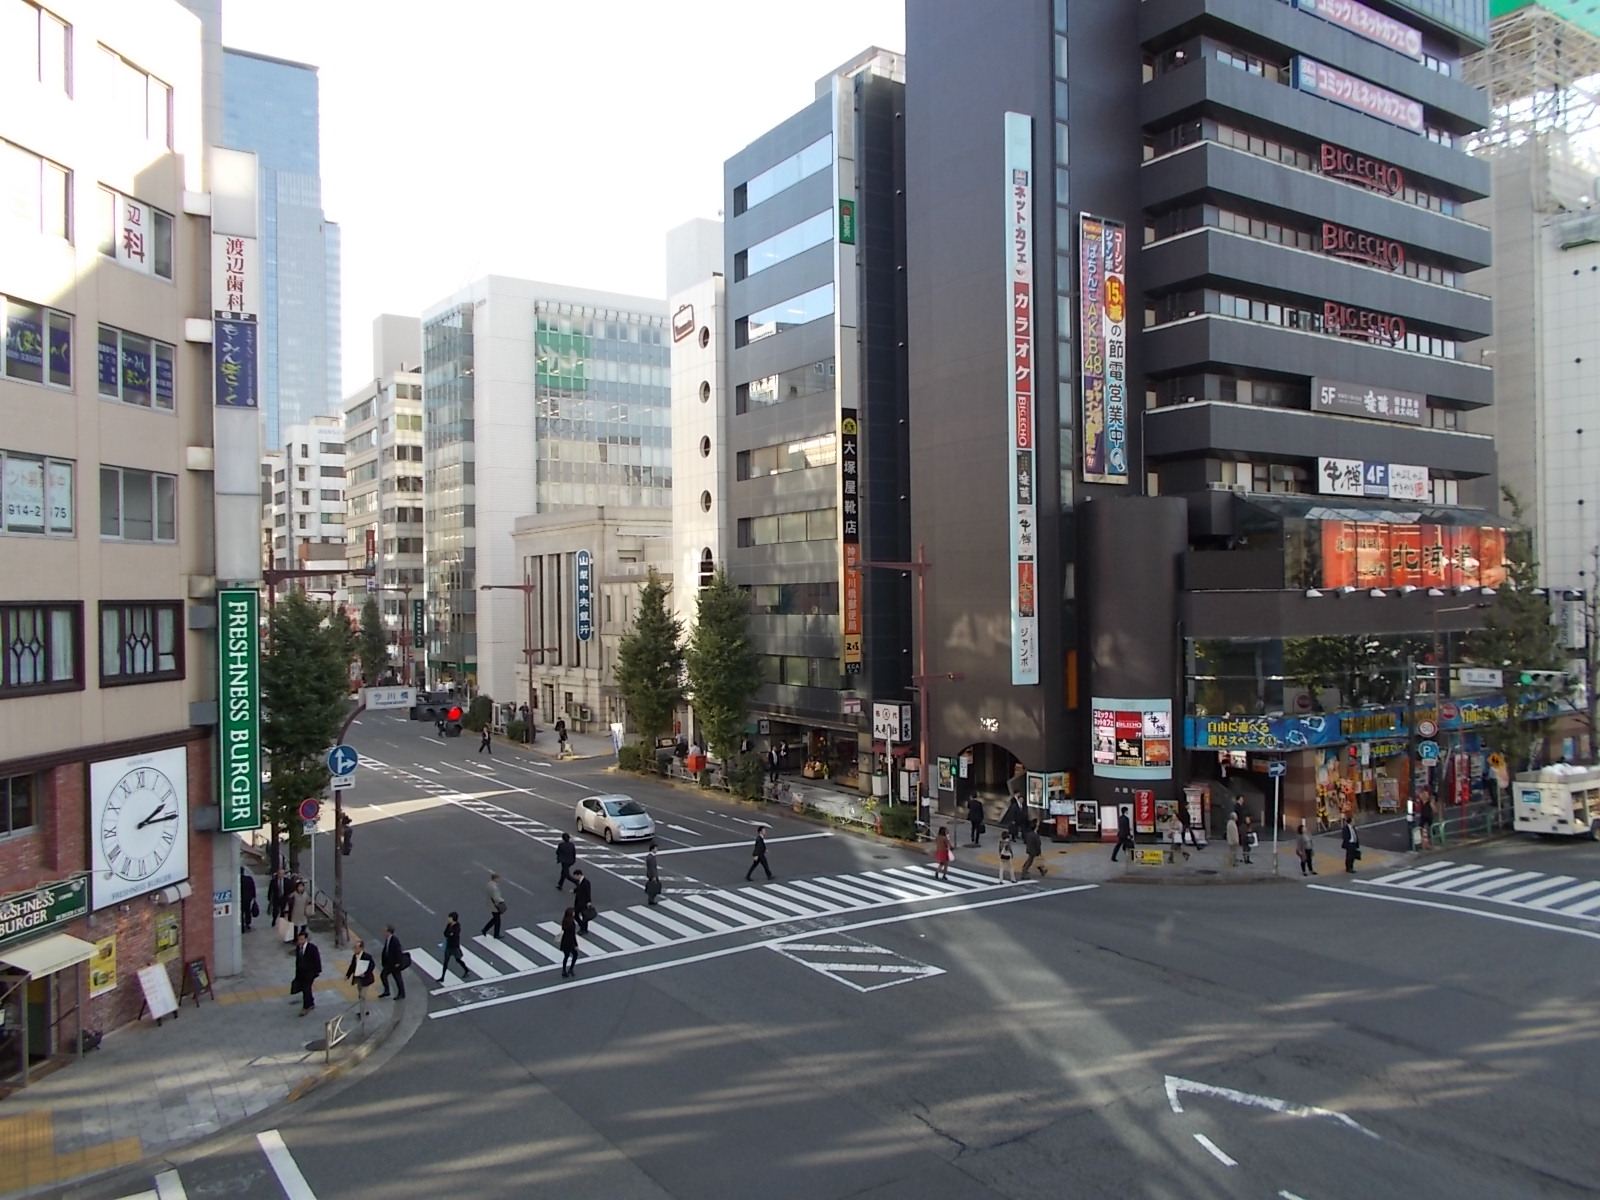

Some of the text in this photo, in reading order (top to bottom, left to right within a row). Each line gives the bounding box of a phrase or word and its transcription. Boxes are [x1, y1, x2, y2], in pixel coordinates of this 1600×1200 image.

[1321, 143, 1403, 194] BIG ECHO
[1014, 186, 1027, 263] ネットカフェ
[1323, 223, 1404, 271] BIG ECHO
[226, 237, 244, 312] 渡辺歯科
[1014, 293, 1030, 381] カラオケ
[1324, 301, 1405, 342] BIG ECHO
[1321, 386, 1336, 404] 5F
[1018, 396, 1028, 447] BIG ECHO
[843, 440, 857, 535] 大塚屋靴店
[1366, 465, 1386, 484] 4F
[578, 556, 590, 634] 山梨中央銀行
[228, 601, 251, 821] FRESHNESS BURGER
[1207, 721, 1270, 733] 自由に遊べる
[1423, 745, 1433, 758] P
[1140, 792, 1149, 819] カラオケ
